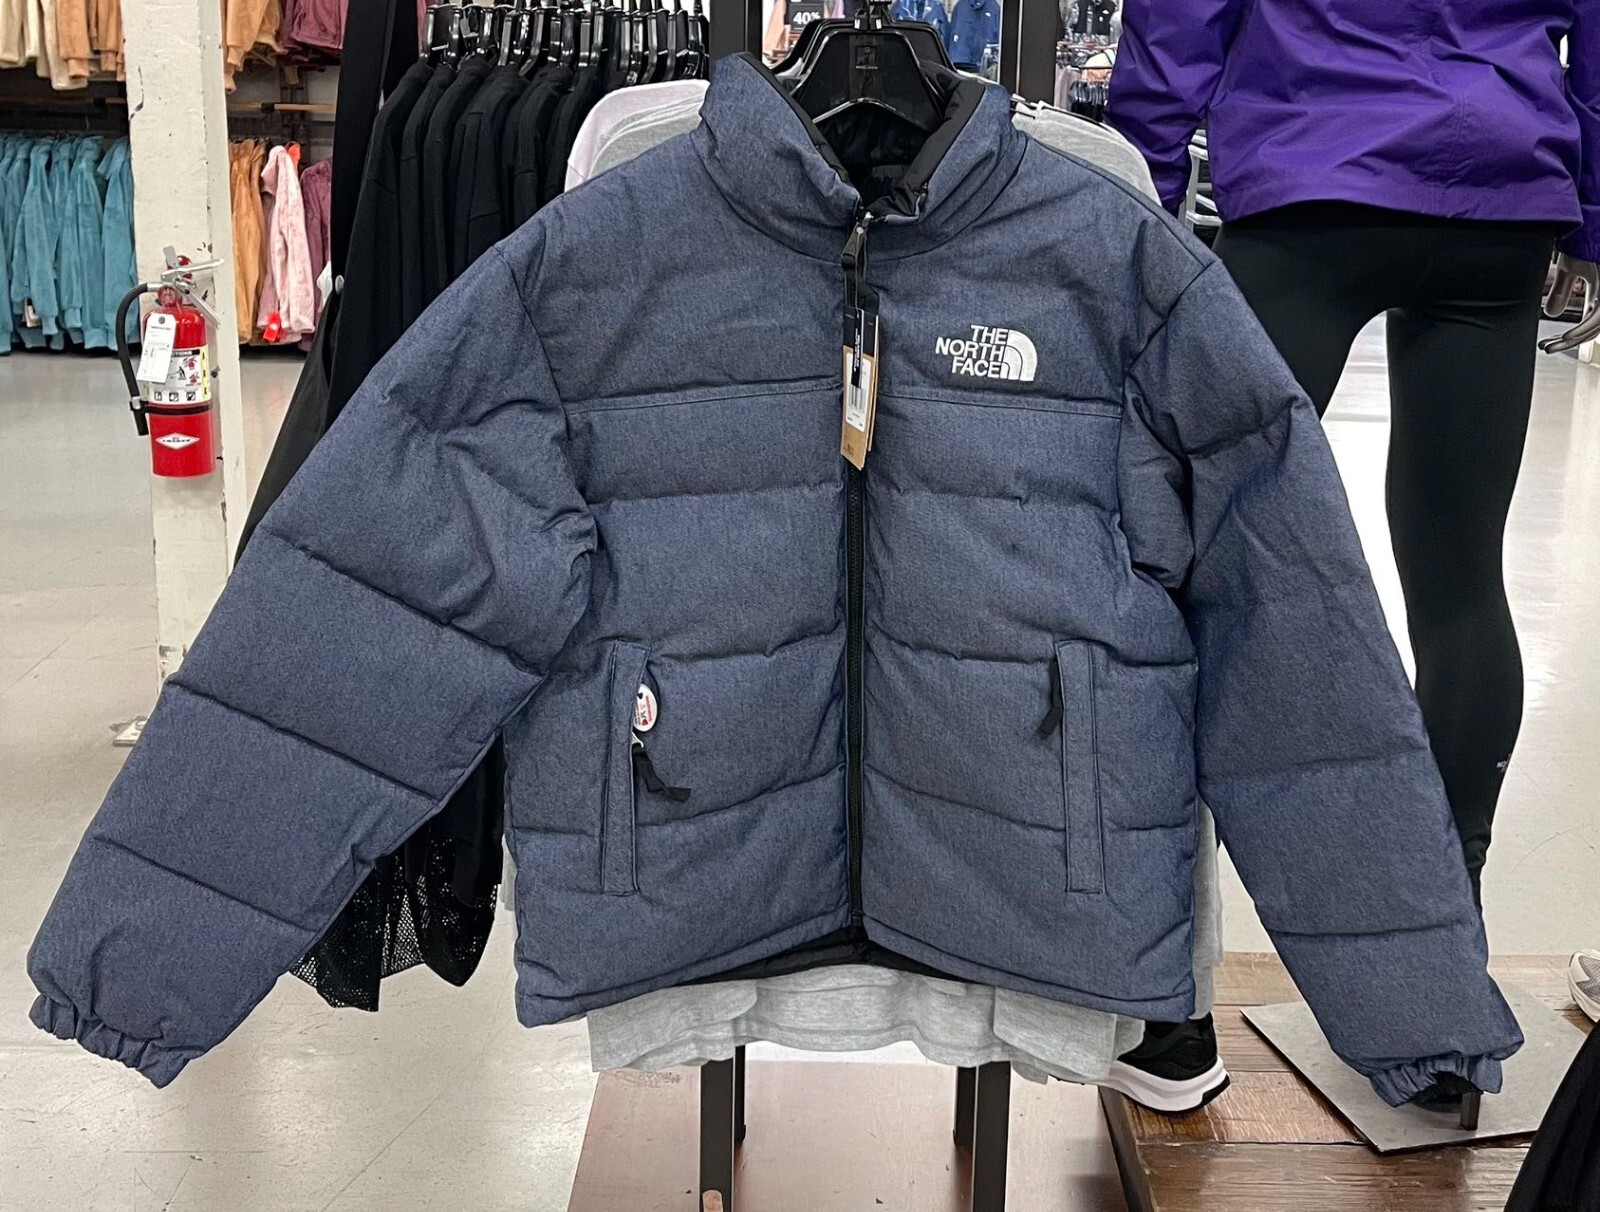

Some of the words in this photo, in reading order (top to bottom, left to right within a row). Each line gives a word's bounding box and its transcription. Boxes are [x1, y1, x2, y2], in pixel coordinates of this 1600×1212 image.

[970, 324, 1008, 344] THE
[935, 336, 1005, 362] NORTH
[951, 356, 1001, 378] FACE
